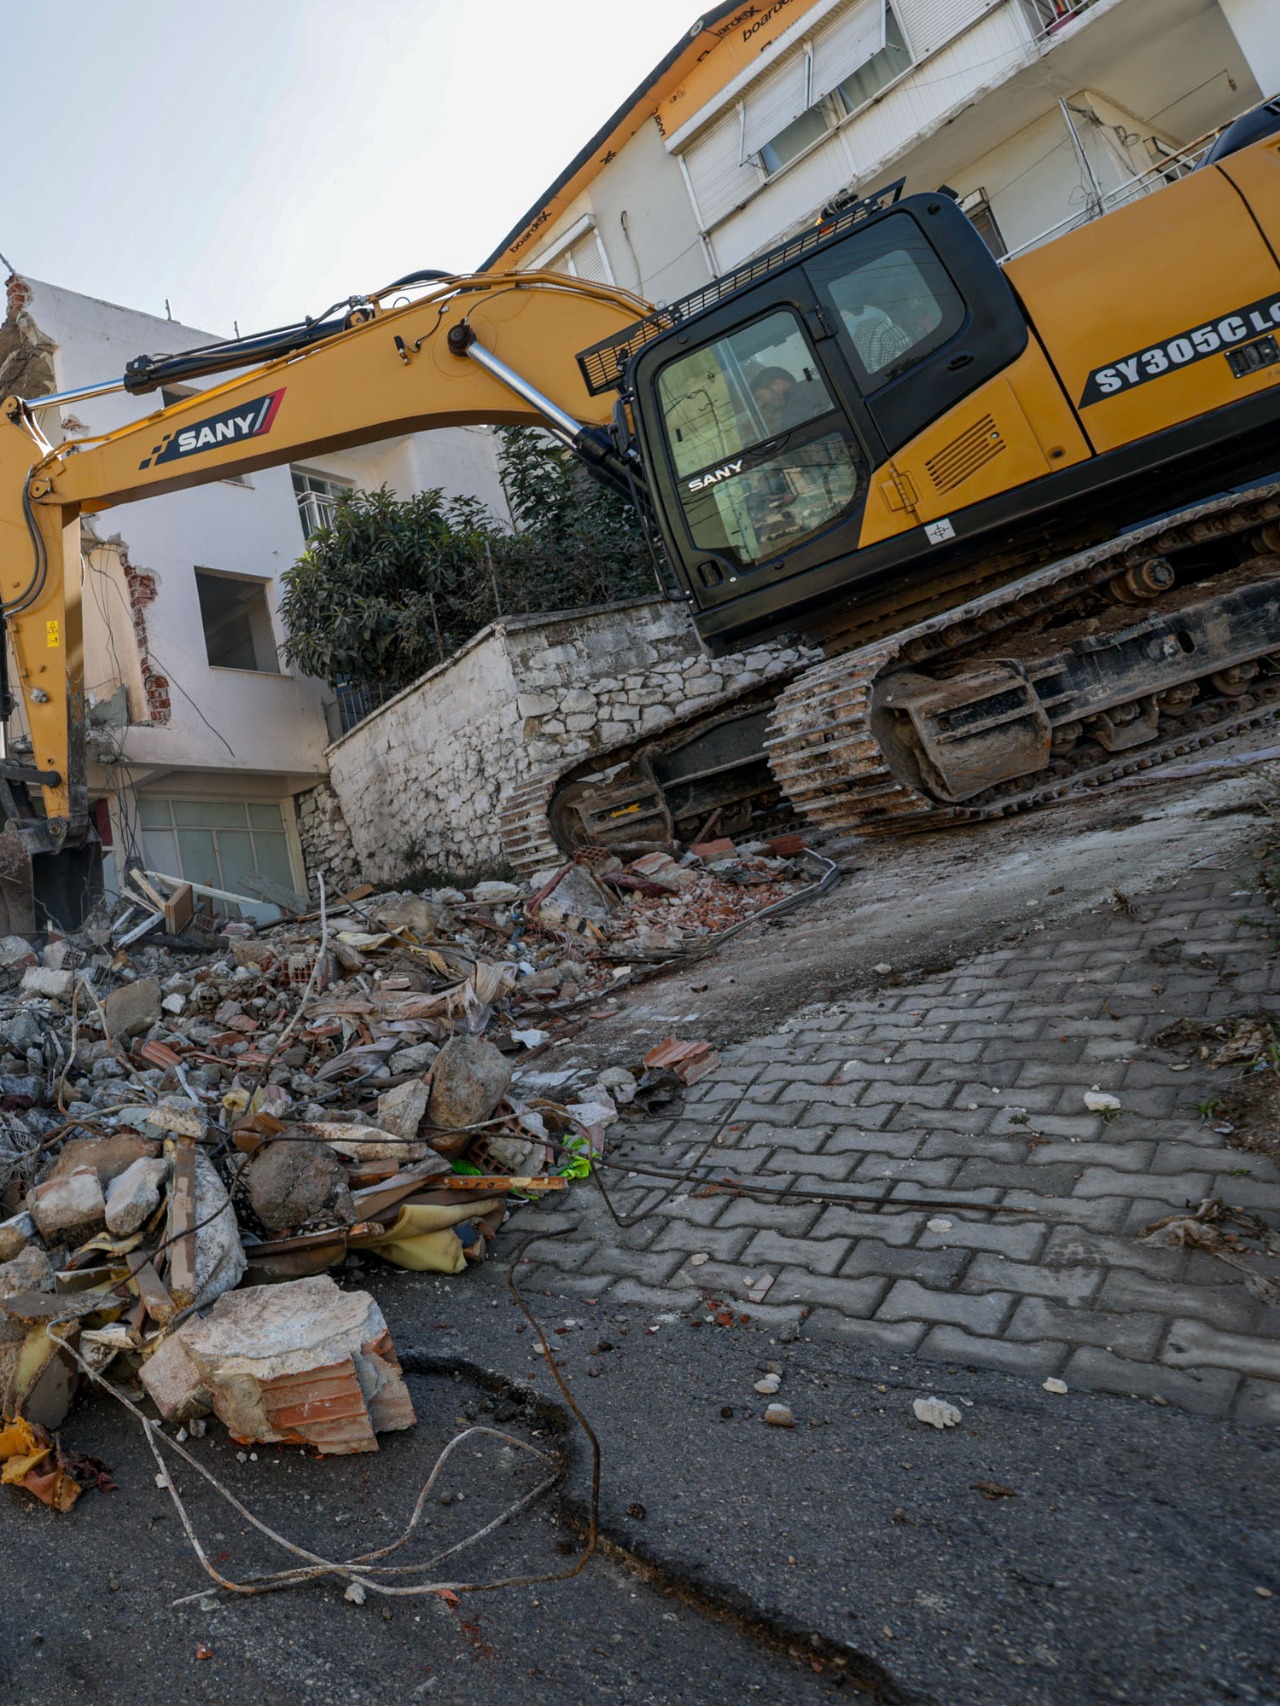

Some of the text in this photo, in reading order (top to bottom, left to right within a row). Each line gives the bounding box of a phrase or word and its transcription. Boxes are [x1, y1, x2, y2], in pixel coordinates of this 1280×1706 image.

[510, 211, 552, 253] boardex
[1095, 316, 1247, 393] SY305C
[178, 412, 255, 453] SANY
[688, 459, 743, 492] SANY
